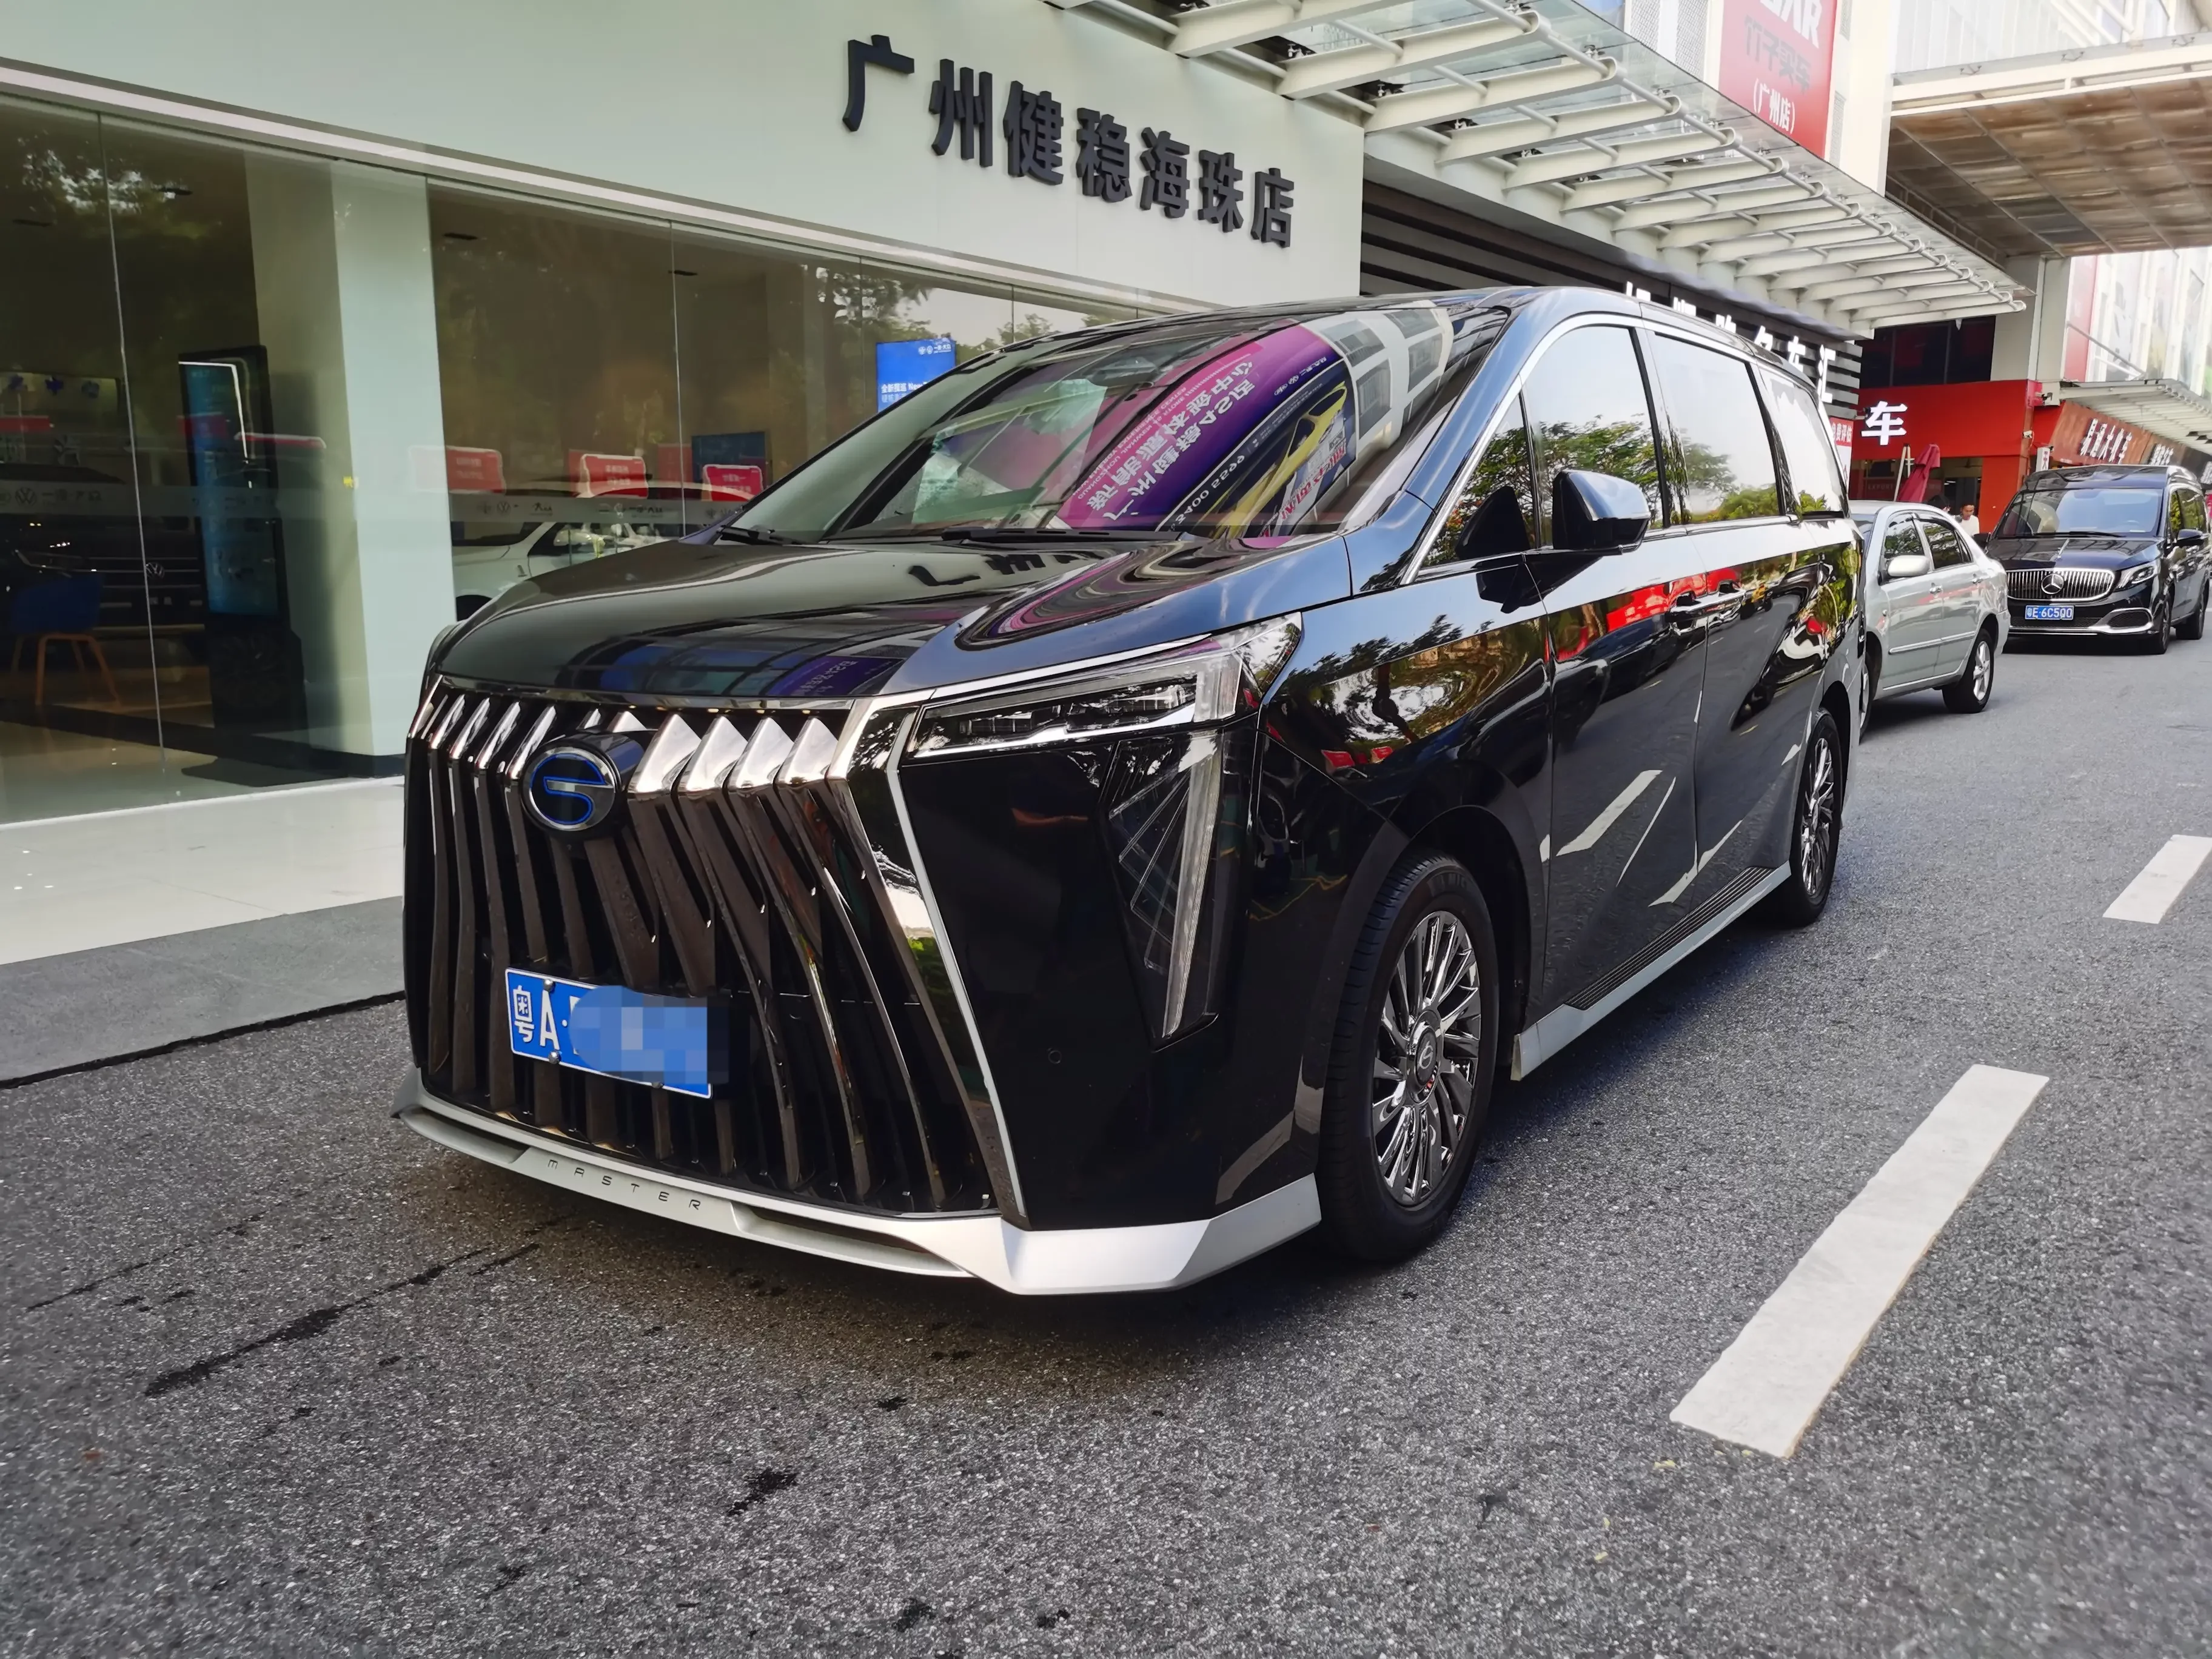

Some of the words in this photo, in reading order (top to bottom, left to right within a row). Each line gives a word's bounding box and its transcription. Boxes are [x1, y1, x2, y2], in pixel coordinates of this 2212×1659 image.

[1744, 13, 1812, 95] 竹子买车
[843, 35, 1295, 249] 广州健稳海珠店
[1860, 401, 1908, 446] 车
[548, 1159, 700, 1210] MASTER
